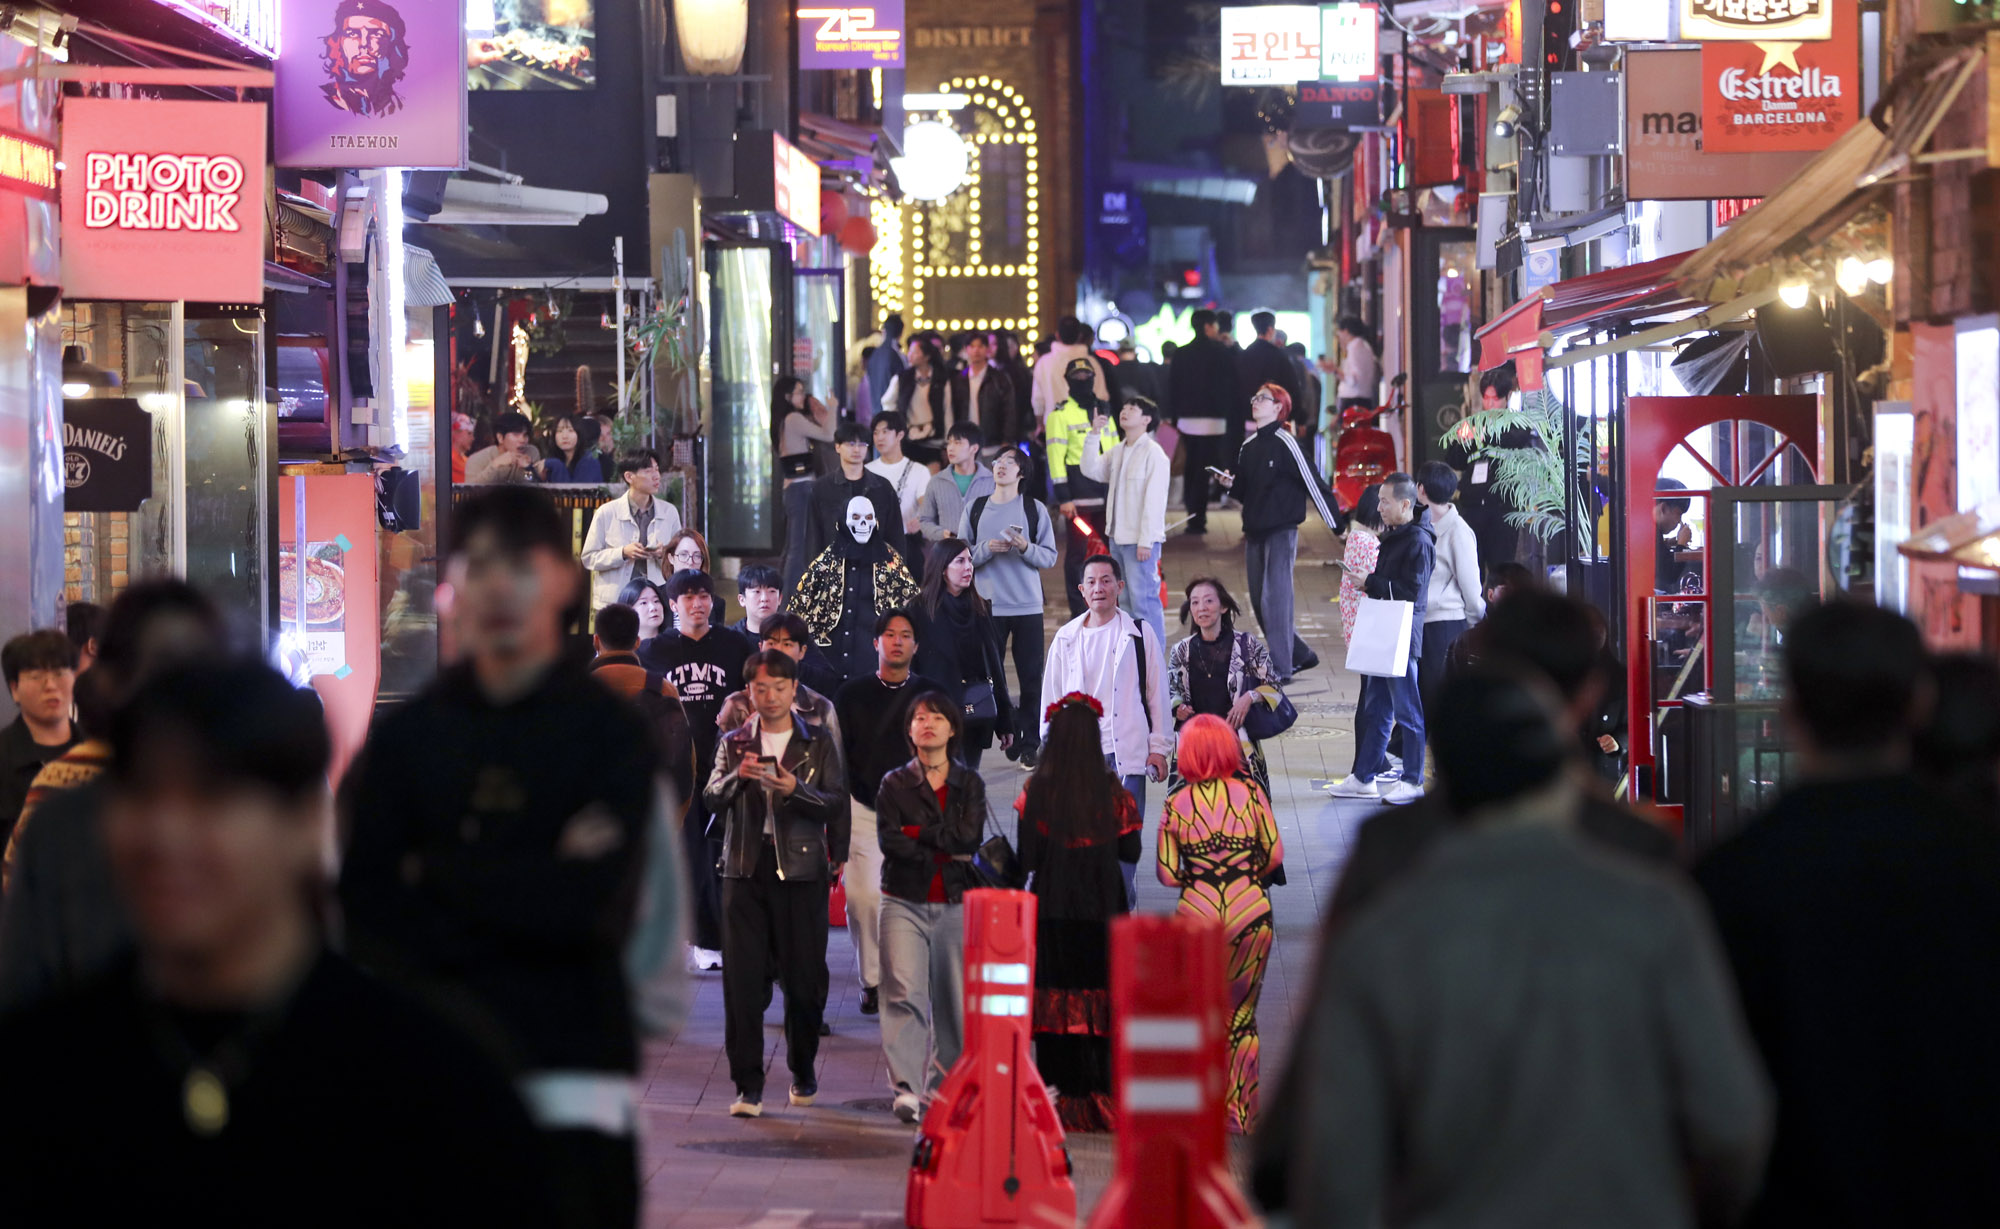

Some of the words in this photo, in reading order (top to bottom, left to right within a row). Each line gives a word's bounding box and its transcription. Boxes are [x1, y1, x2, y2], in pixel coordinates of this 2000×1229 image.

[915, 27, 1032, 47] DISTRICT
[815, 41, 849, 52] Korean
[851, 41, 881, 55] Dining
[882, 41, 900, 52] Bar
[1231, 31, 1320, 61] 코인노
[1331, 52, 1367, 64] PUB
[1718, 66, 1842, 101] Estrella
[1301, 87, 1375, 102] DANCO
[1761, 100, 1797, 111] Damm
[1642, 111, 1702, 135] ma
[1733, 112, 1827, 125] BARCELONA
[330, 135, 398, 149] ITAEWON
[86, 151, 245, 194] PHOTO
[85, 190, 241, 232] DRINK
